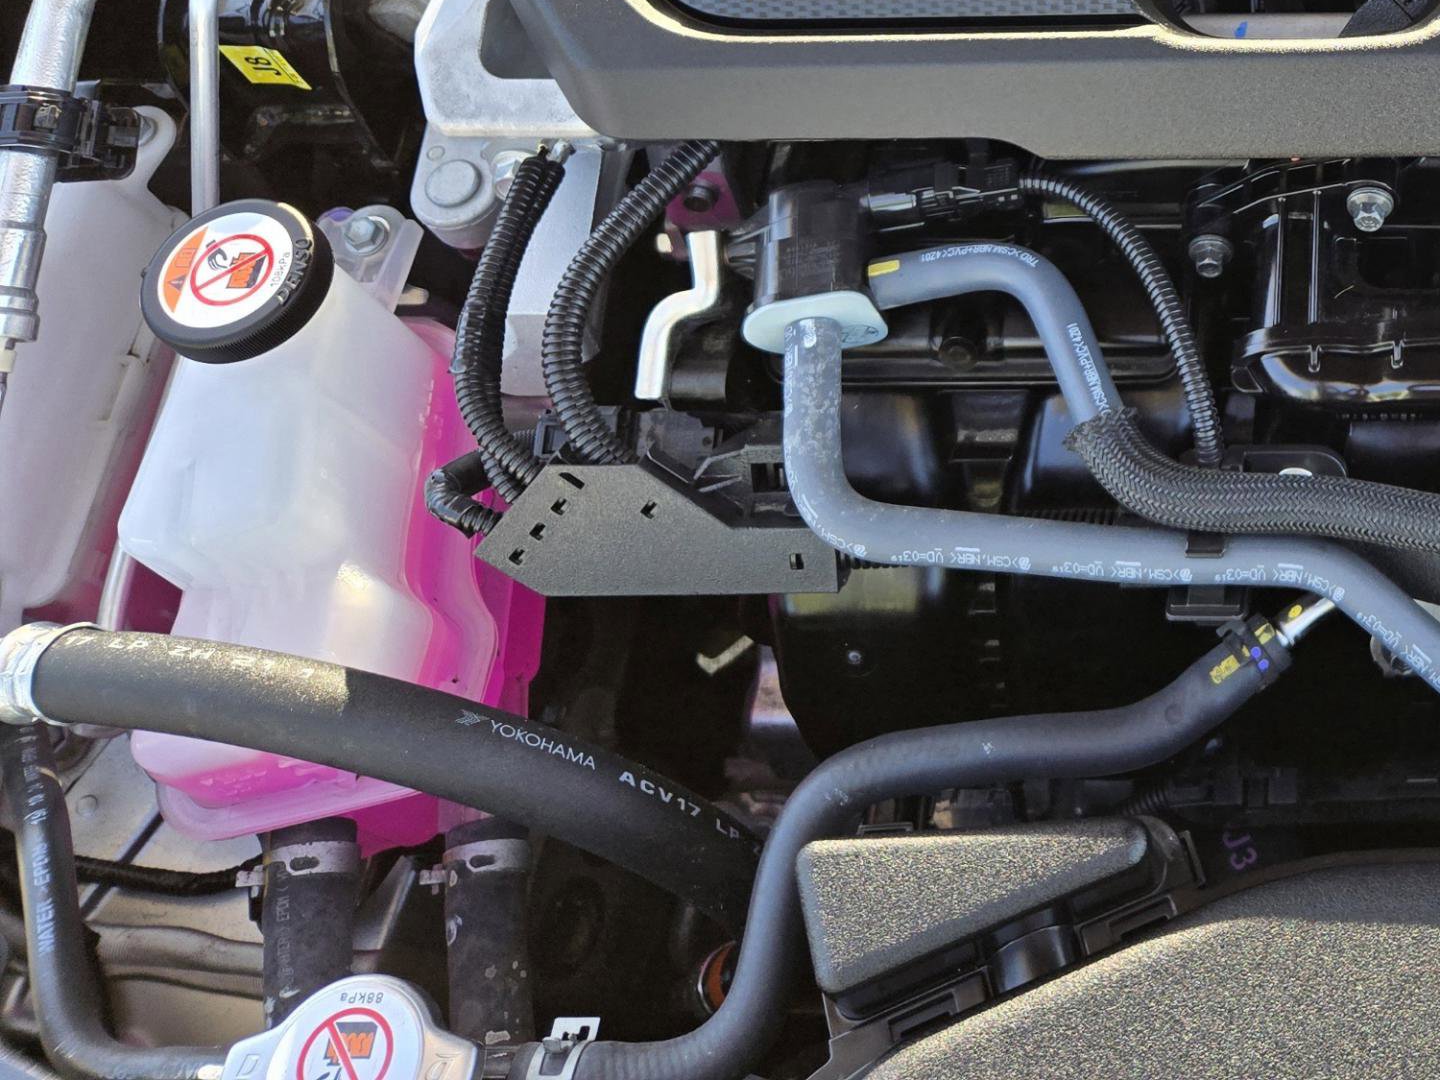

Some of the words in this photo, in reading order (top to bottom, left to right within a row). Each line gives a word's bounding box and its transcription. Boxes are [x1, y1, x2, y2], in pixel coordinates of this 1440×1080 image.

[275, 238, 314, 306] DENSO
[490, 719, 597, 771] YOKOHAMA
[618, 770, 702, 818] ACV17
[339, 991, 385, 1005] 88kPa
